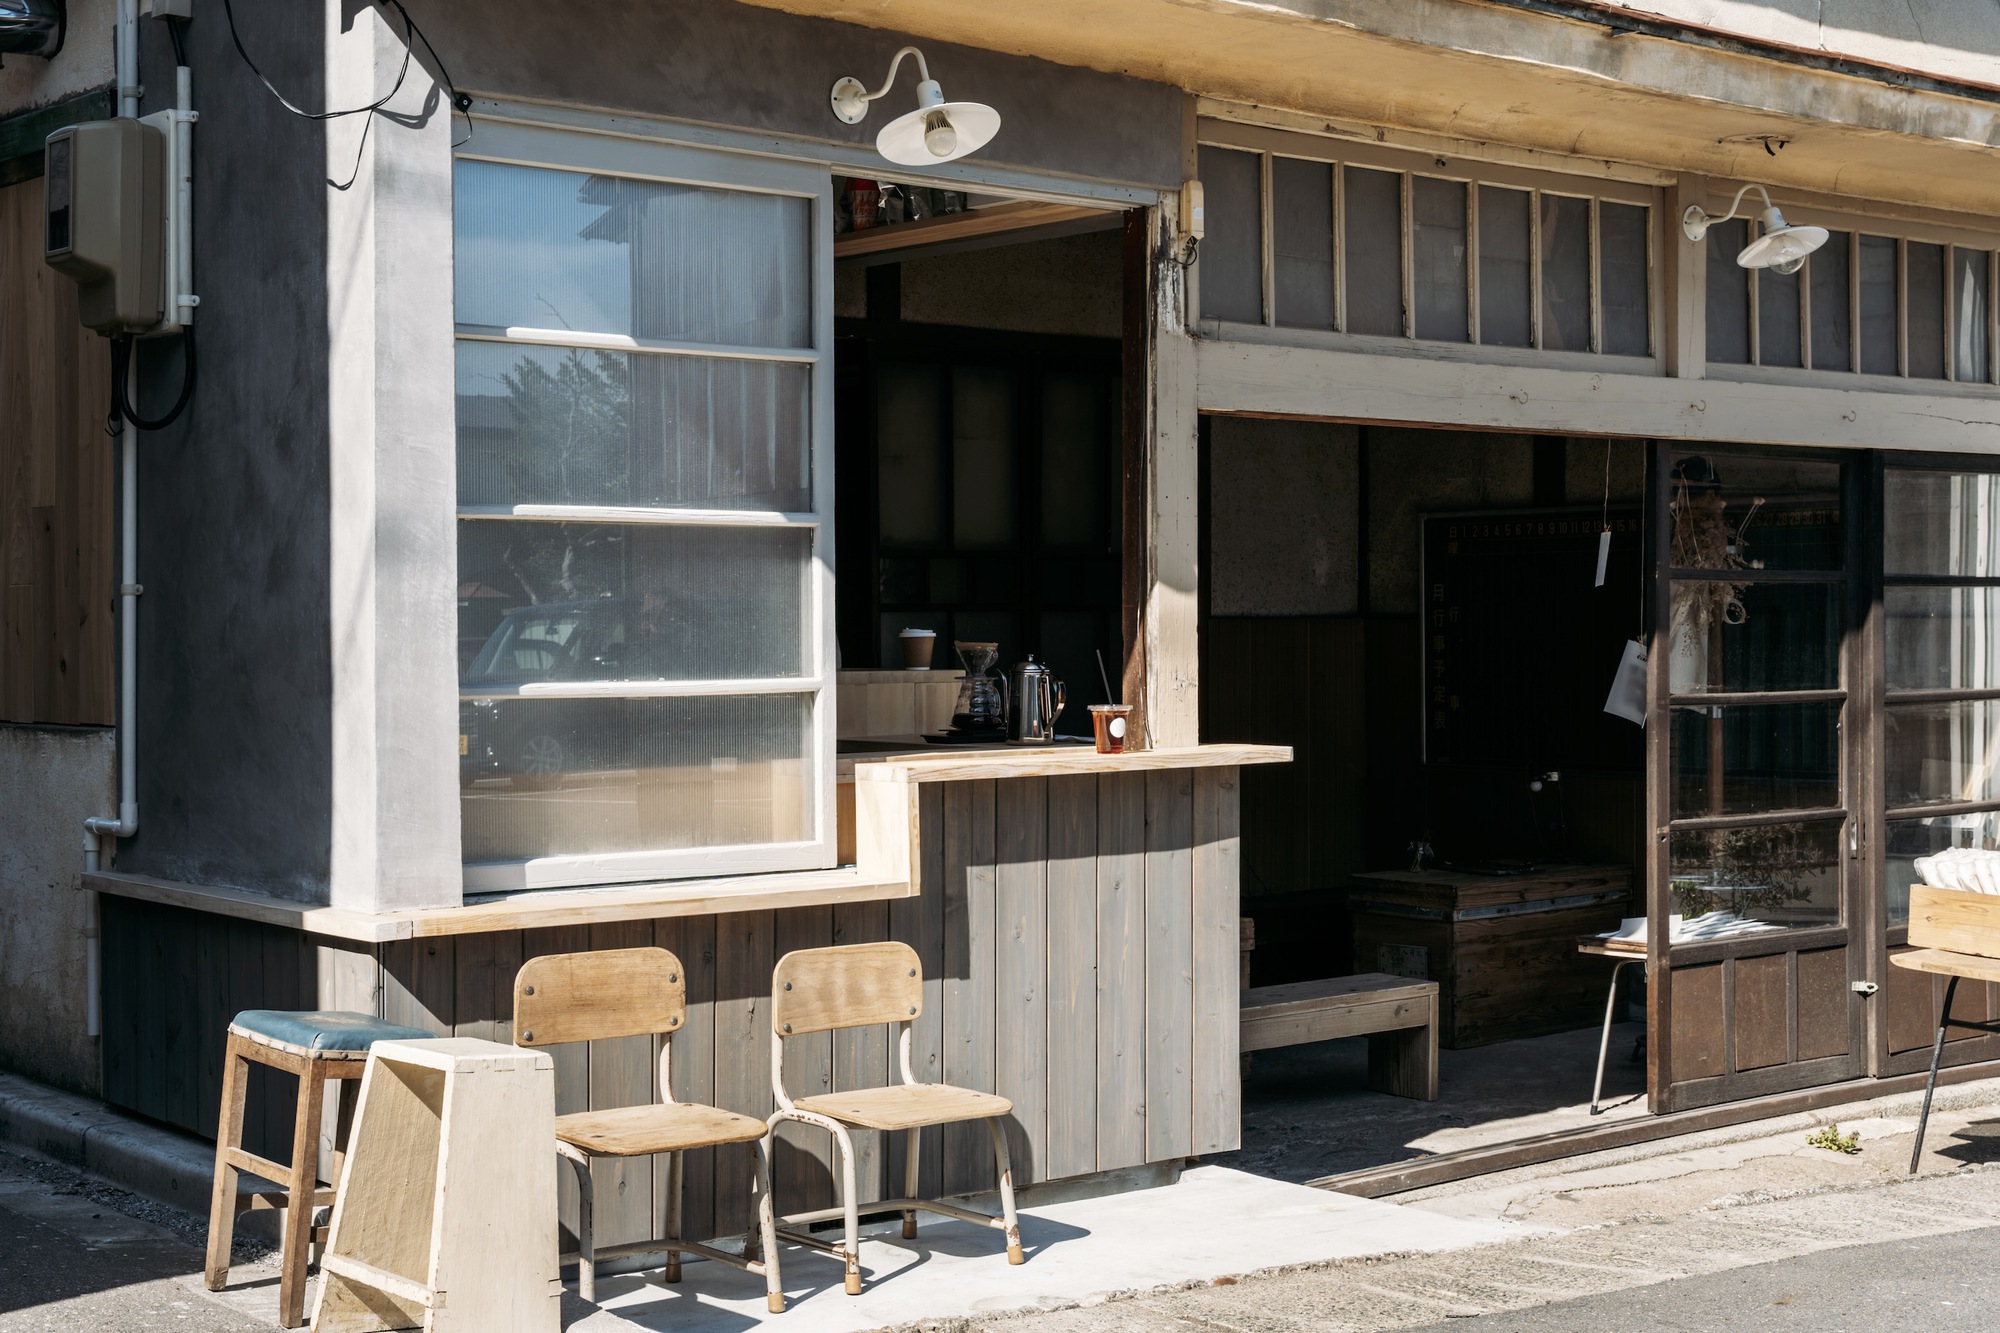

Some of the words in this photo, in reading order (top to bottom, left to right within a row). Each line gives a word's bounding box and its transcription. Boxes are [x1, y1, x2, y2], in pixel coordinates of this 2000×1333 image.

[1449, 526, 1457, 538] 日
[1472, 525, 1478, 538] 2
[1483, 525, 1489, 537] 3
[1494, 524, 1500, 536] 4
[1504, 523, 1511, 536] 5
[1515, 523, 1522, 536] 6
[1526, 522, 1533, 535] 7
[1537, 522, 1544, 535] 8
[1548, 521, 1555, 535] 9
[1559, 521, 1568, 534] 10
[1571, 520, 1578, 534] 11
[1582, 520, 1590, 534] 12
[1593, 520, 1602, 533] 13
[1616, 519, 1625, 532] 15
[1628, 519, 1637, 532] 16
[1763, 513, 1774, 526] 27
[1776, 512, 1787, 526] 28
[1789, 511, 1801, 525] 29
[1802, 511, 1813, 525] 30
[1816, 510, 1826, 524] 31
